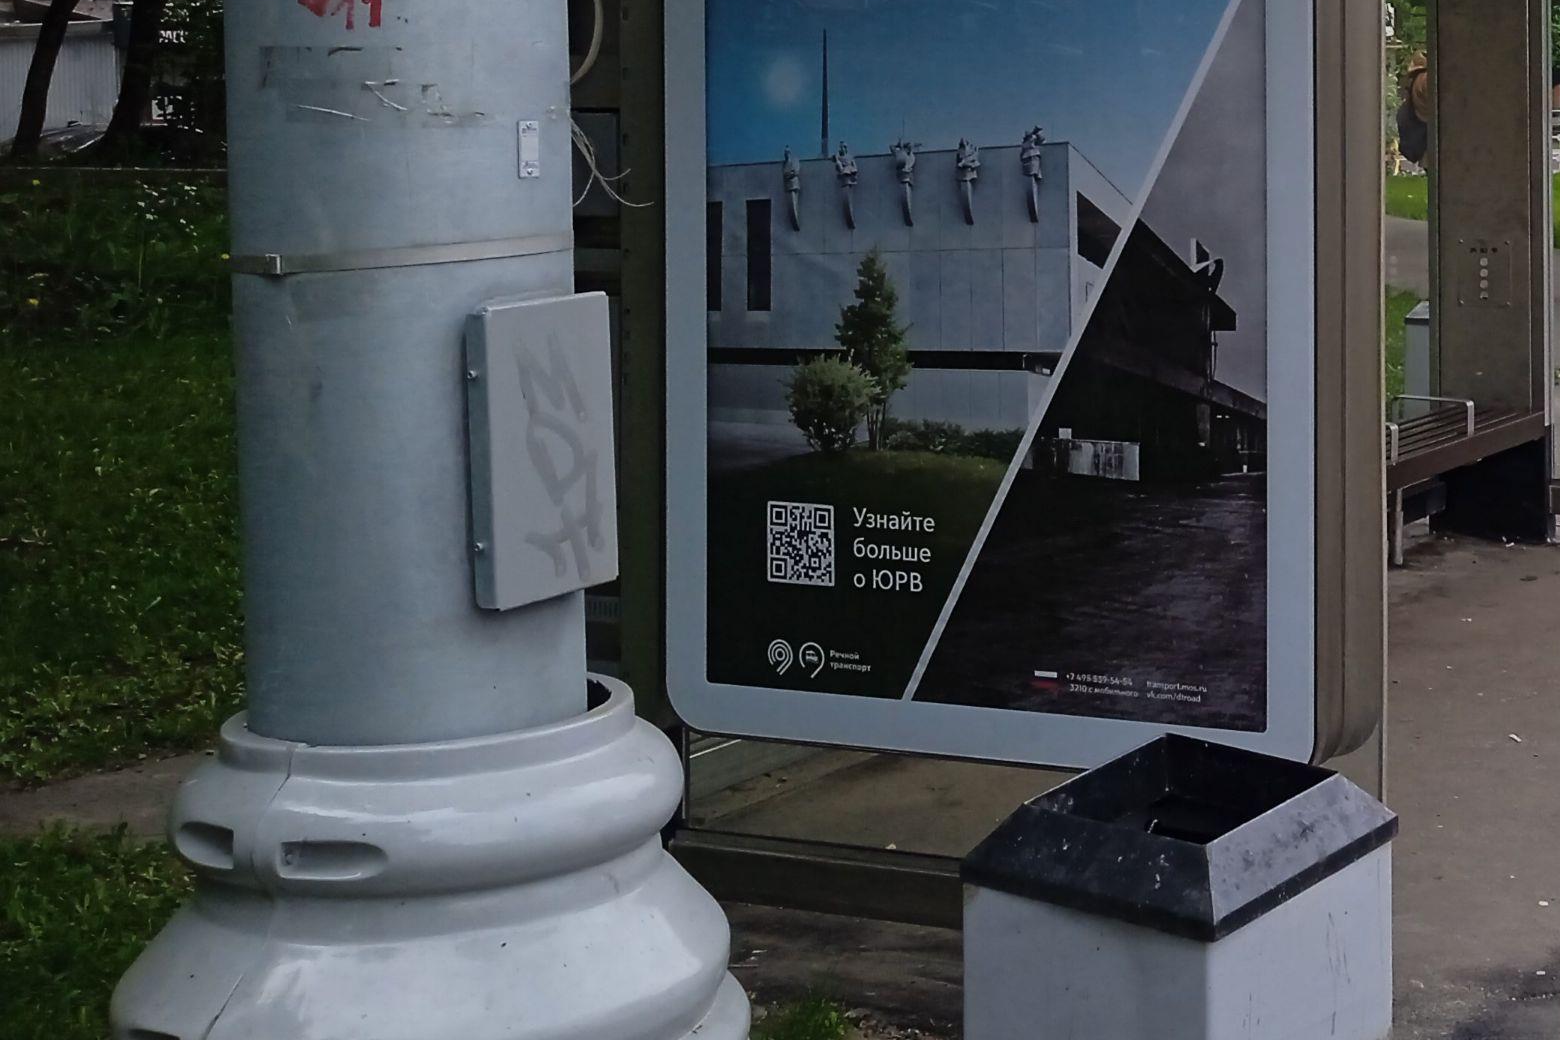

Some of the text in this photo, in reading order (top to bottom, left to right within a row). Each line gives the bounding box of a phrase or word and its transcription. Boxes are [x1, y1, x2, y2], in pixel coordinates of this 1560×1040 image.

[853, 507, 936, 532] Узнайте
[853, 537, 932, 563] больше
[853, 569, 923, 592] о ЮРВ
[830, 650, 860, 660] Речной
[830, 662, 871, 673] транспорт
